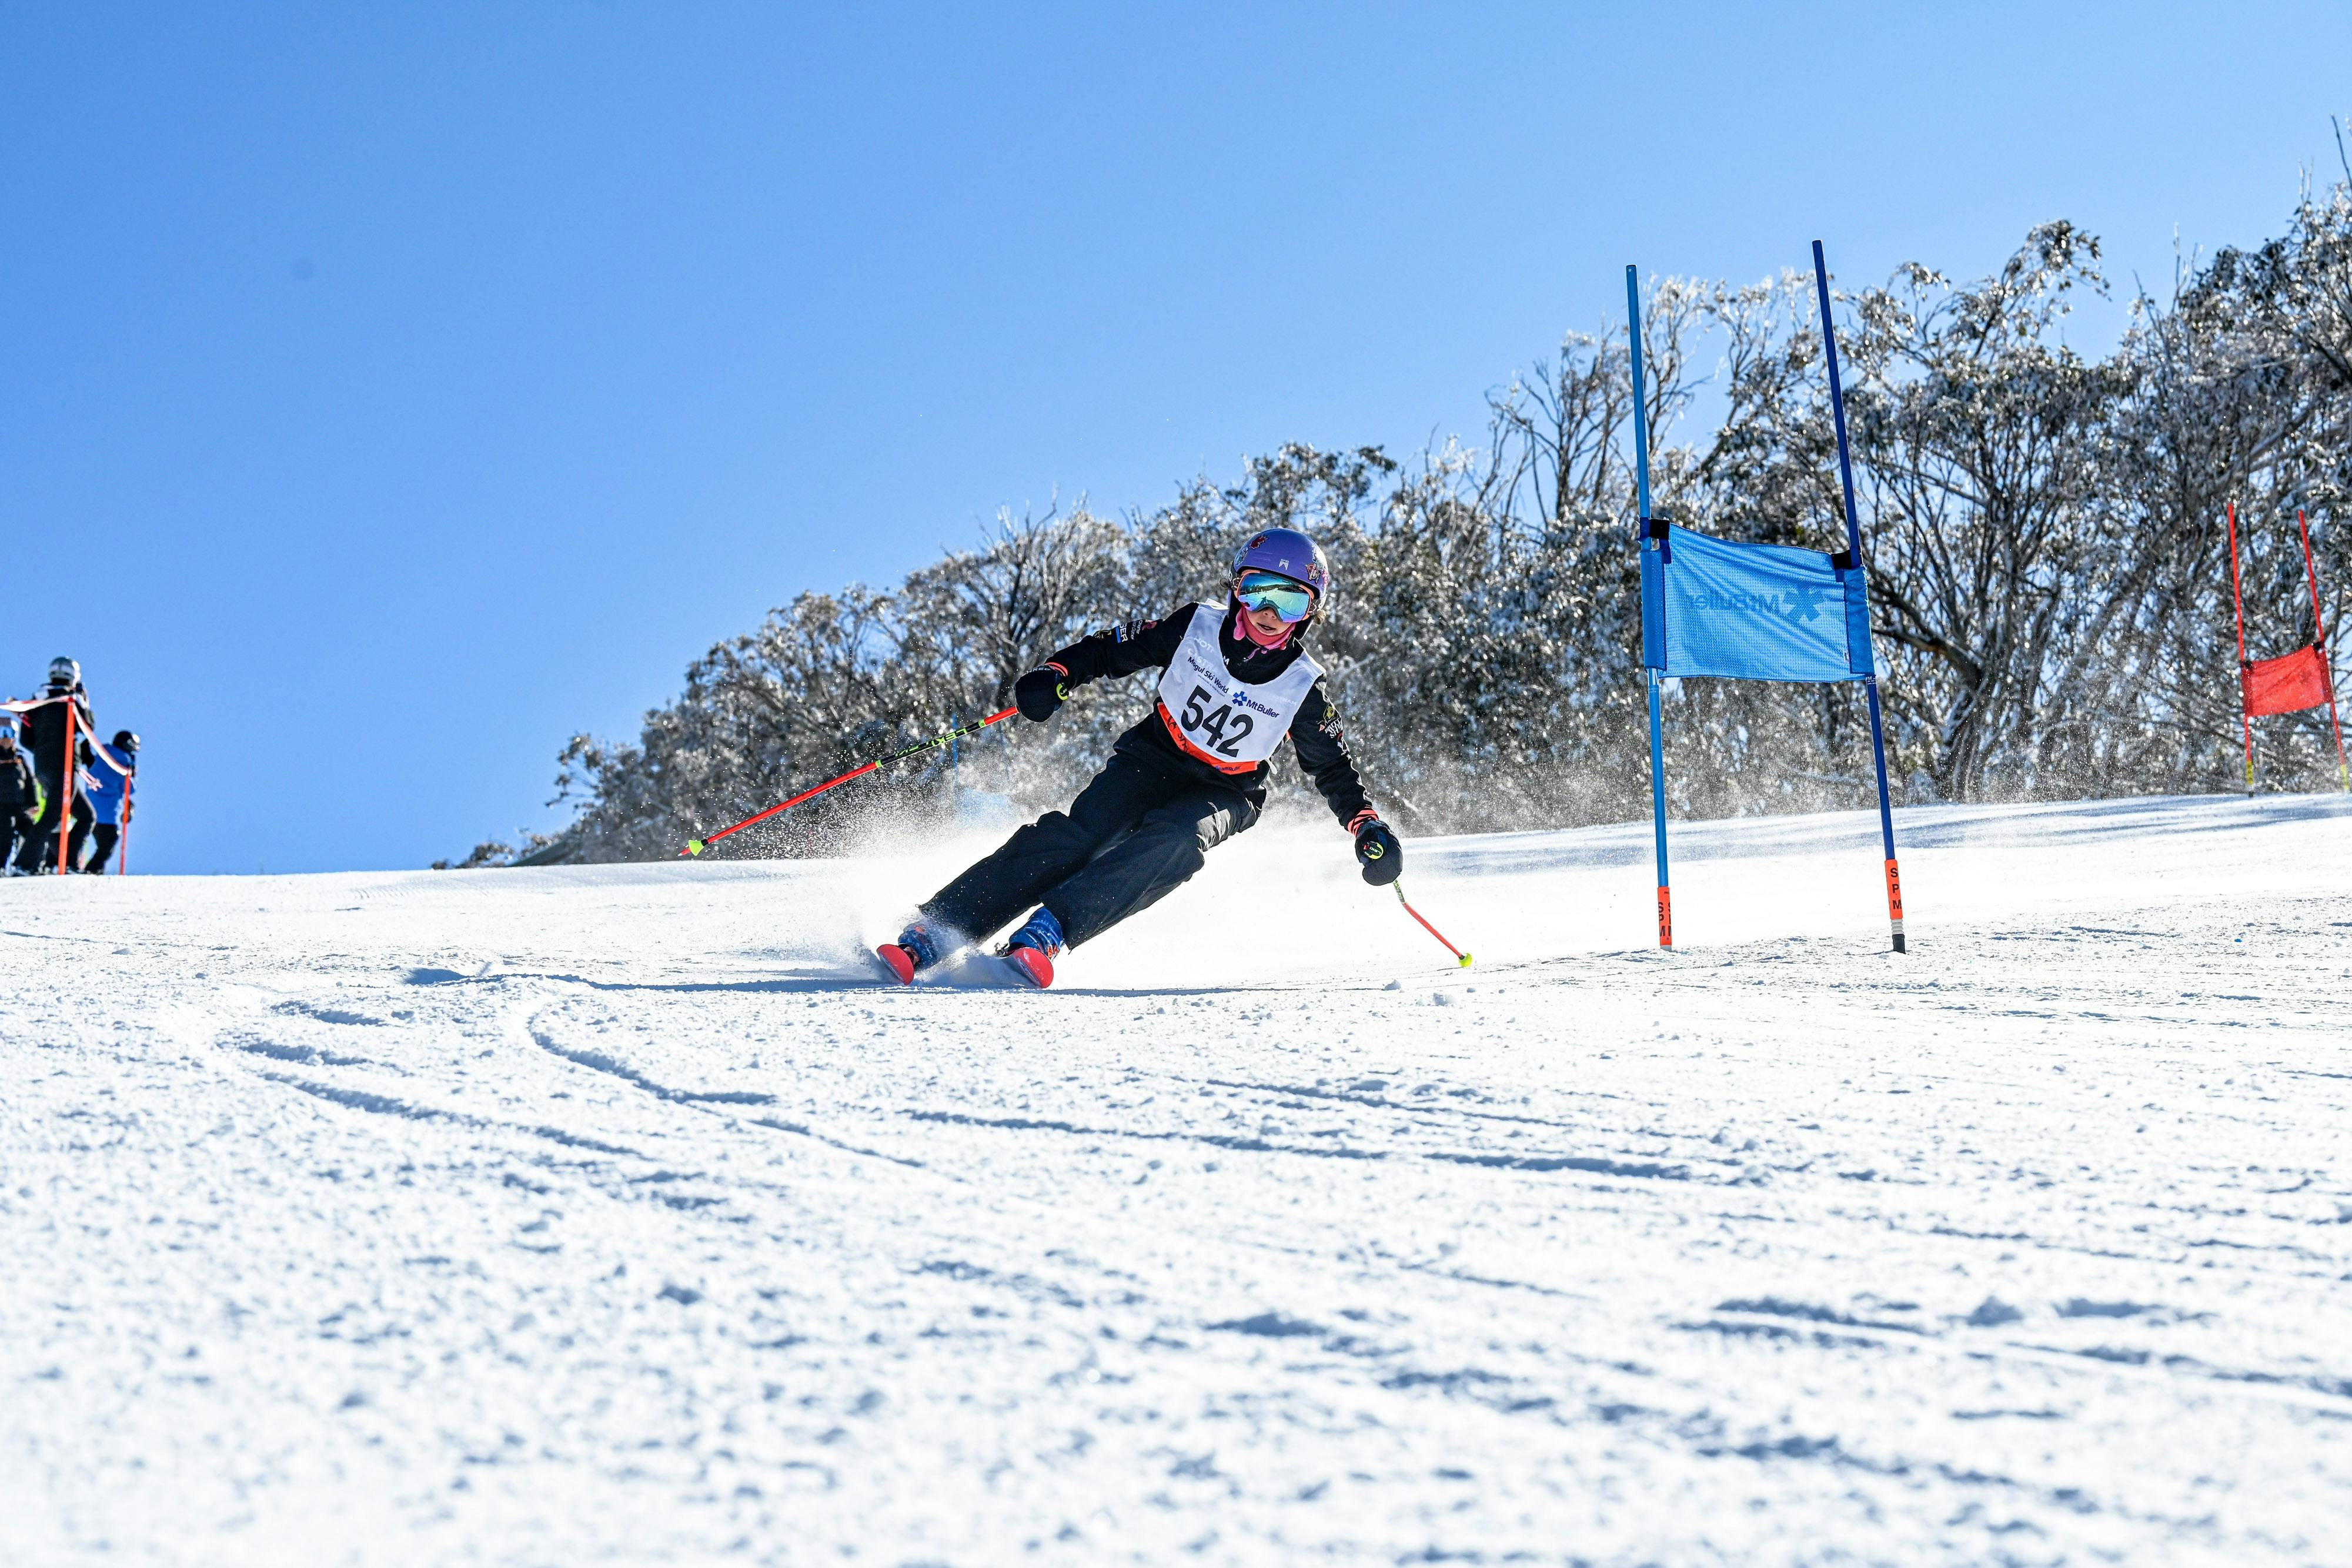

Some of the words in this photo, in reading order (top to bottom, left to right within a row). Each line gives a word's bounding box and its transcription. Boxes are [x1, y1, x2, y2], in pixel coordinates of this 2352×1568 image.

[1187, 656, 1205, 674] Mogul
[1204, 670, 1215, 681] Ski
[1214, 677, 1229, 694] World
[1181, 684, 1254, 758] 542
